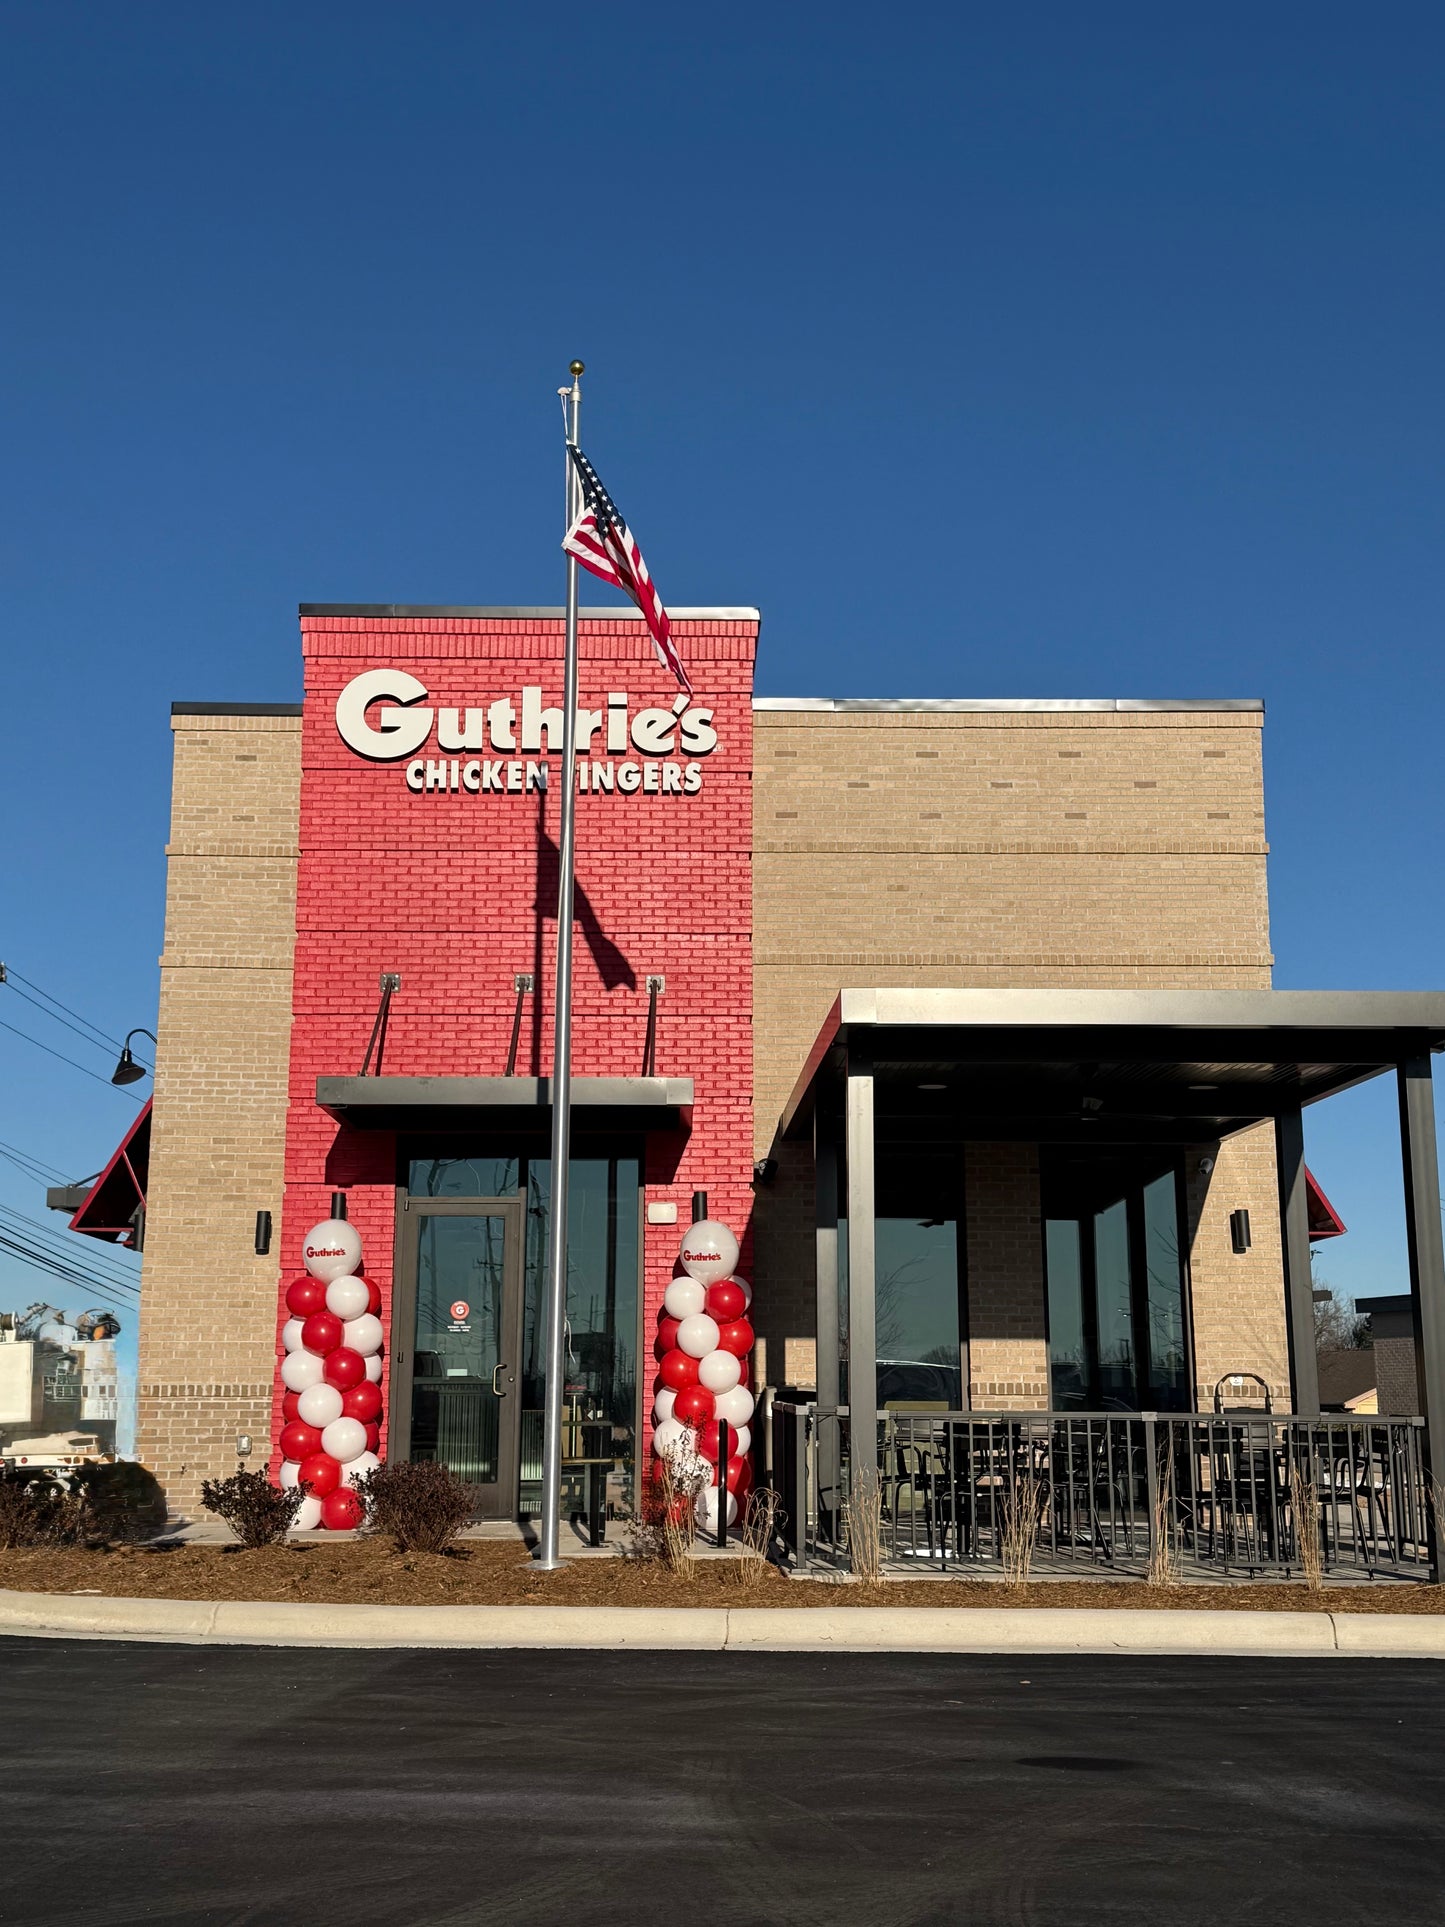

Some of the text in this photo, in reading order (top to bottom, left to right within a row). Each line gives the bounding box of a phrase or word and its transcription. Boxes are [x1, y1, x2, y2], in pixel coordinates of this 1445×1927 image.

[336, 668, 718, 760] Guthrie's
[406, 760, 702, 791] CHICKEN INGERS
[306, 1246, 346, 1258] Guthrie's
[683, 1250, 721, 1261] Guthrie's
